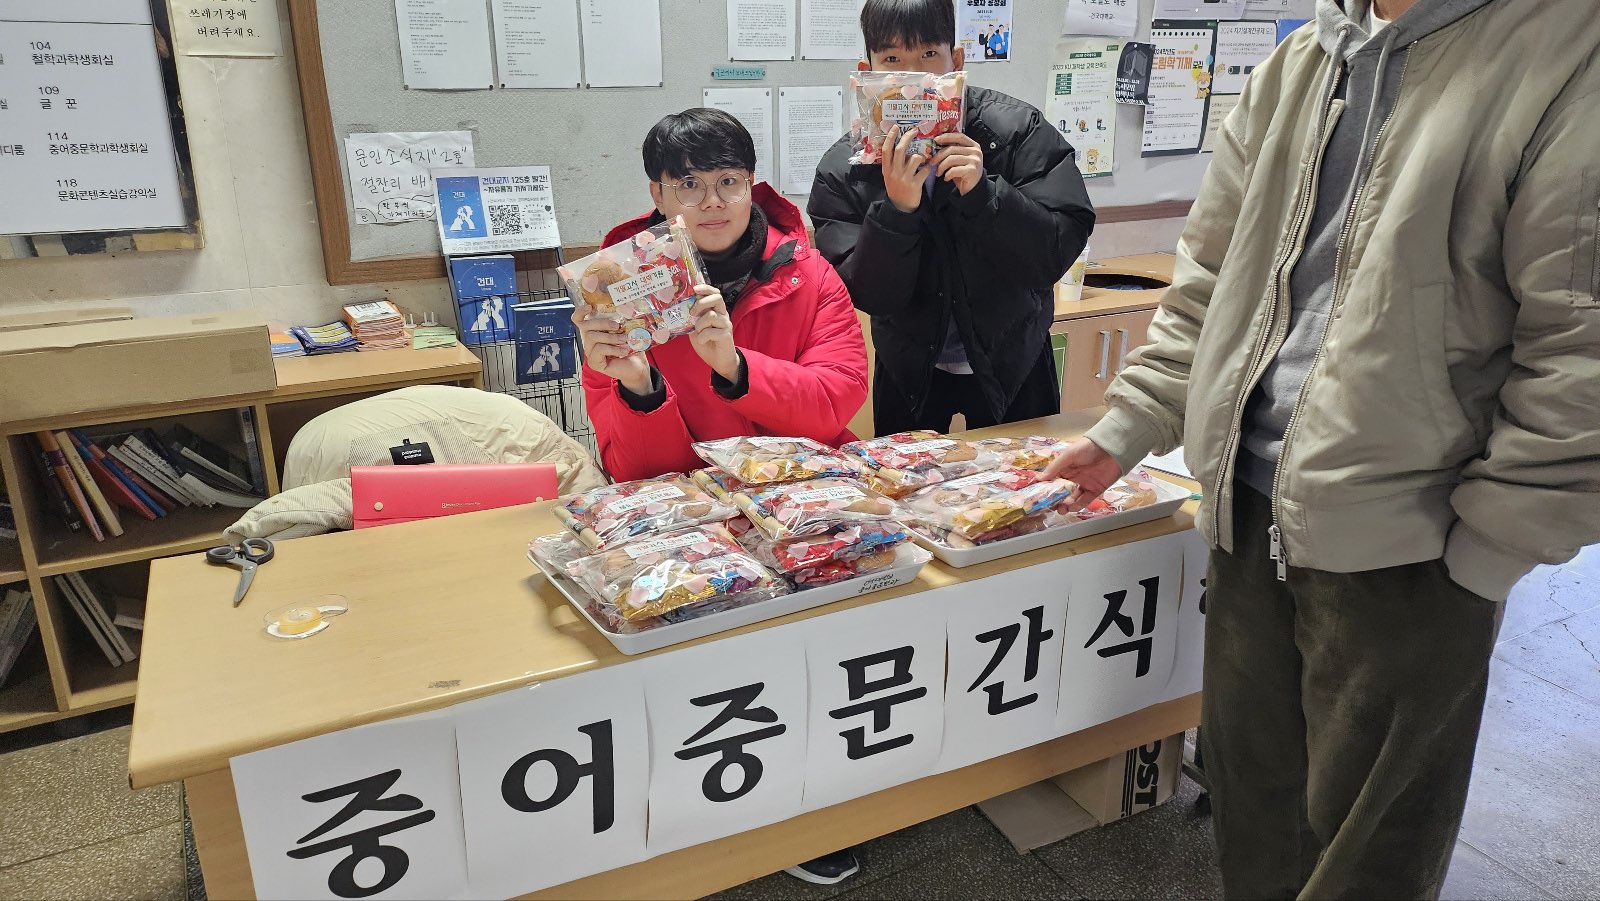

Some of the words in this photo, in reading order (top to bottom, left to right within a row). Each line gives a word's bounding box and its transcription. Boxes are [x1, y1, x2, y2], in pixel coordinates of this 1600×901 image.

[189, 8, 247, 20] 쓰레기장에
[197, 26, 260, 38] 버려주세요.
[29, 41, 51, 51] 104
[32, 53, 114, 66] 철학과학생회실
[38, 86, 60, 95] 109
[39, 98, 52, 110] 글
[65, 98, 78, 110] 꾼
[47, 132, 68, 141] 114
[0, 144, 25, 156] 디룸
[48, 142, 149, 155] 중어중문학과학생회실
[56, 178, 78, 188] 118
[511, 175, 531, 184] 125호
[57, 187, 157, 202] 문화콘텐츠실습강의실
[476, 276, 495, 287] 건대
[537, 324, 554, 335] 건대
